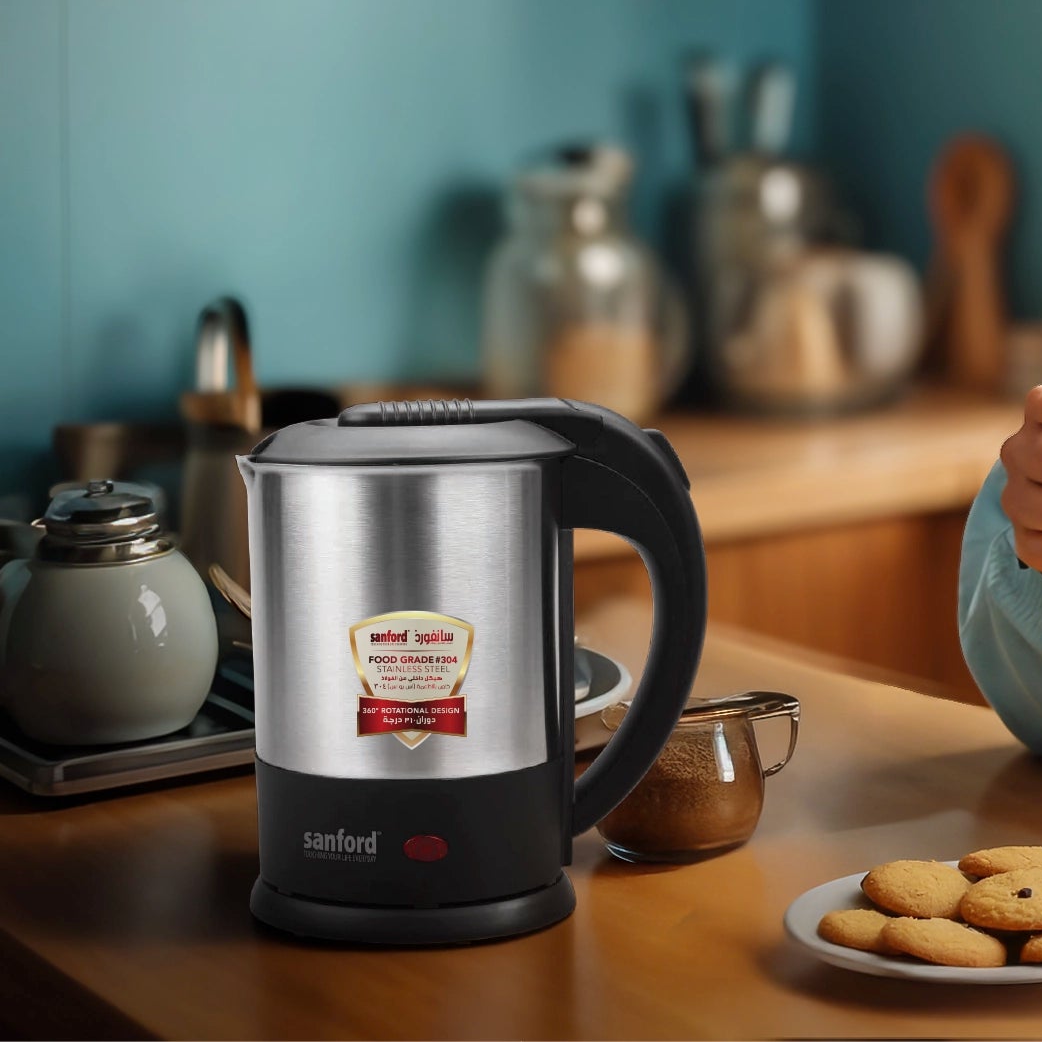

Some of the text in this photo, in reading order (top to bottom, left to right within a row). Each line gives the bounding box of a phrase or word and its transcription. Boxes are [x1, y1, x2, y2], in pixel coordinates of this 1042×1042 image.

[370, 630, 408, 642] sanford
[376, 665, 450, 673] STAINLESS STEEL
[304, 828, 377, 855] sanford
